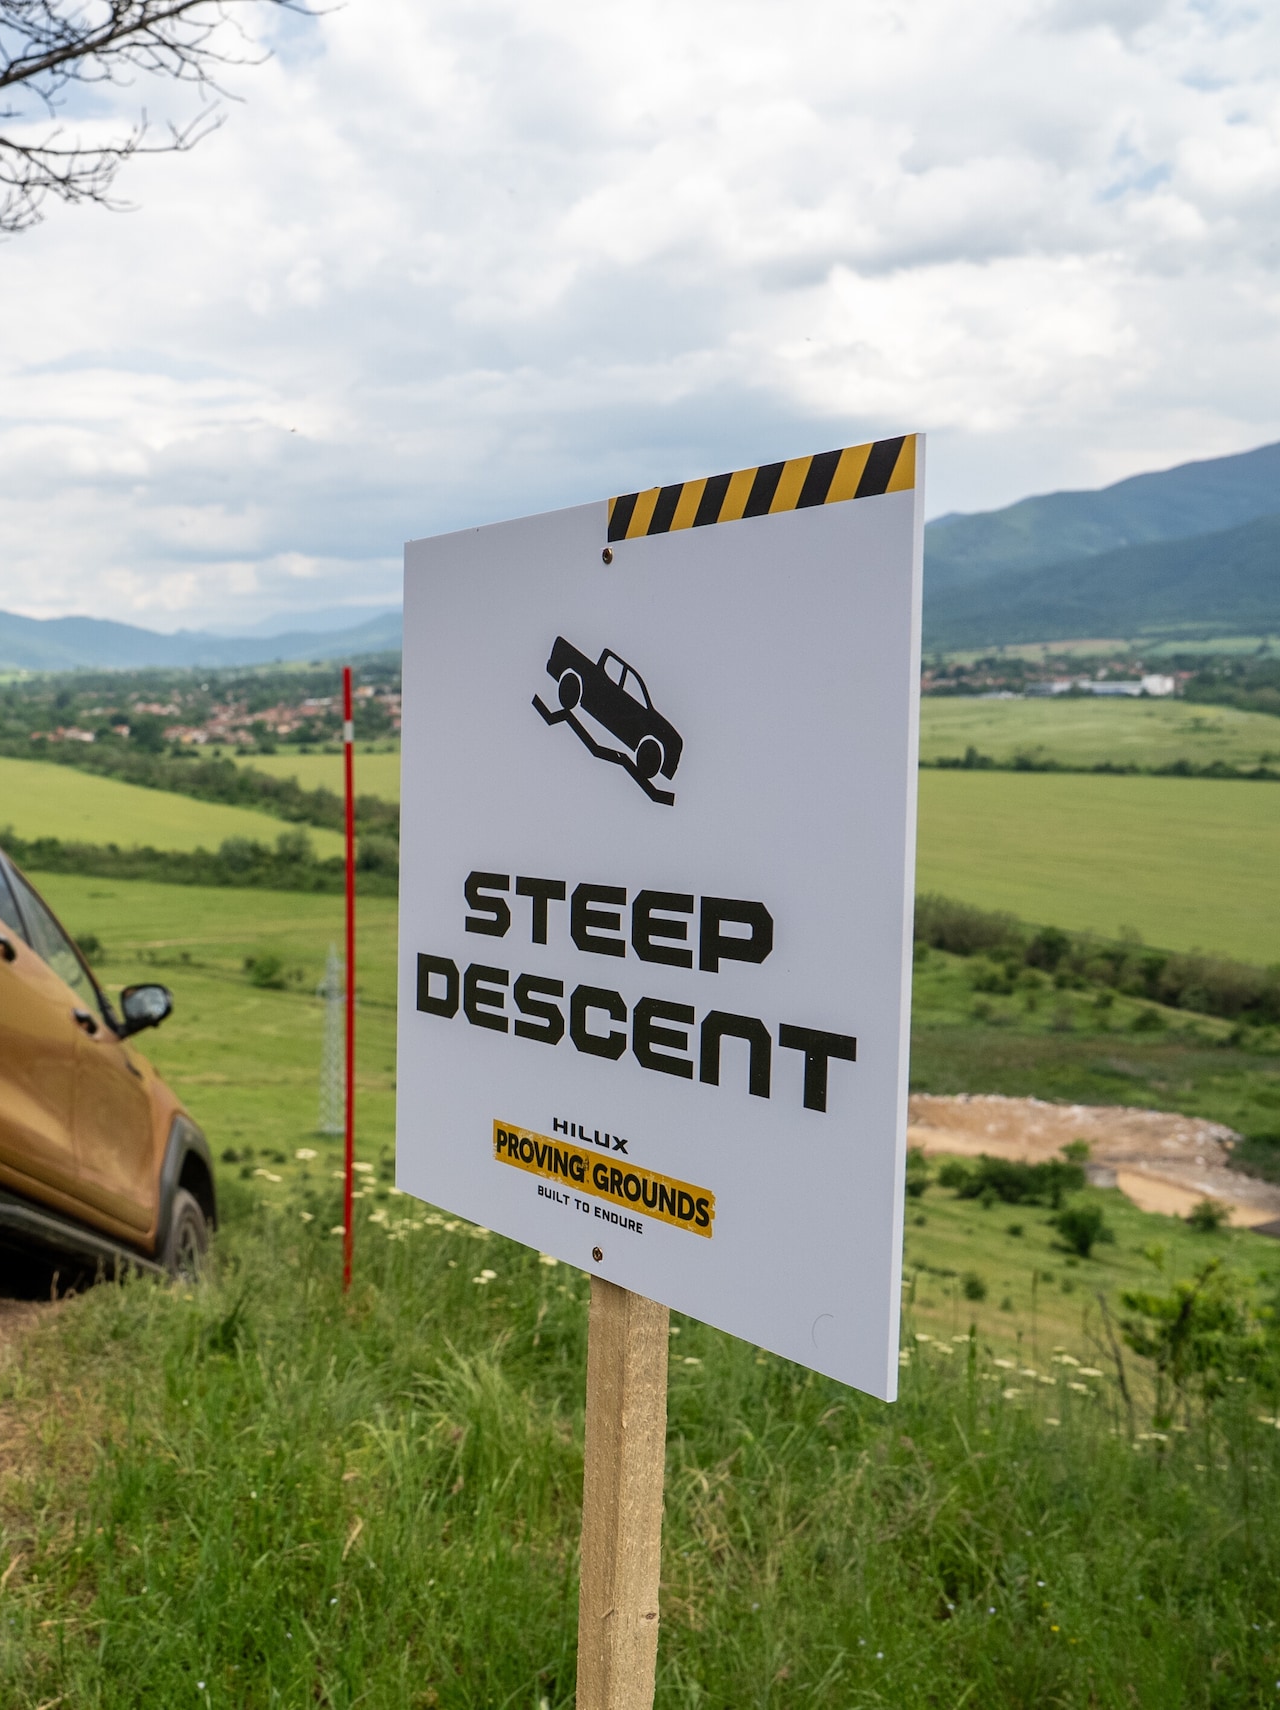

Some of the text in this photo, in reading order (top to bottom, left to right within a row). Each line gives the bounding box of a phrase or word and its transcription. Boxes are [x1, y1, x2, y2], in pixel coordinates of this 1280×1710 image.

[464, 870, 774, 974] STEEP
[416, 952, 857, 1113] DESCENT
[496, 1128, 710, 1228] PROVING GROUNDS
[553, 1117, 629, 1155] HILUX
[537, 1184, 643, 1235] BUILT TO ENDURE
